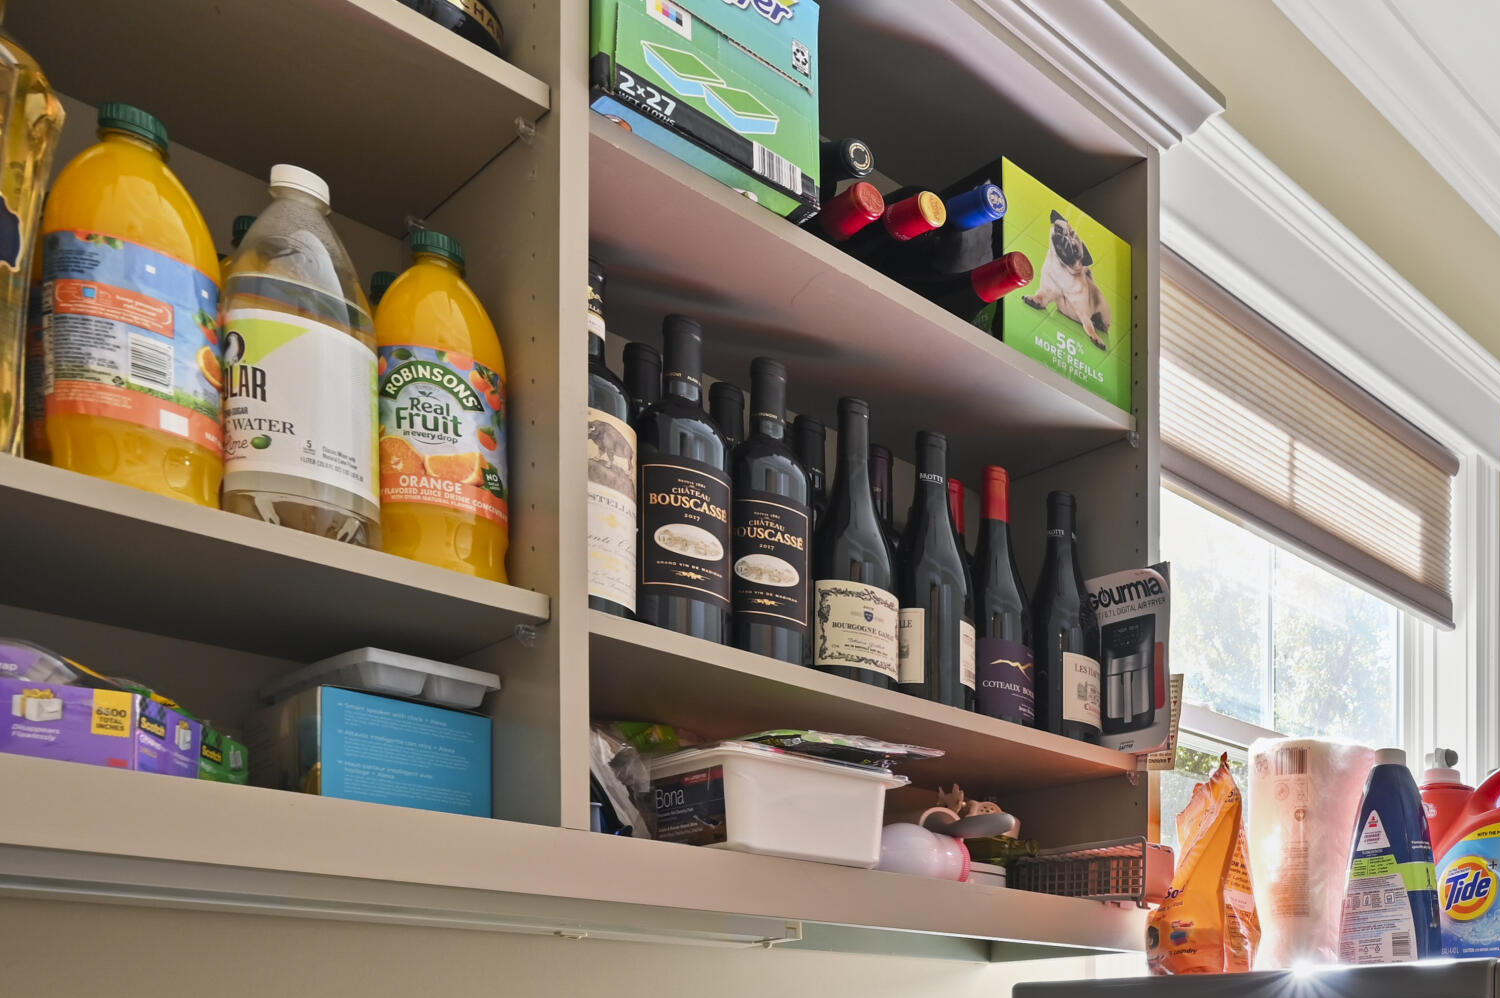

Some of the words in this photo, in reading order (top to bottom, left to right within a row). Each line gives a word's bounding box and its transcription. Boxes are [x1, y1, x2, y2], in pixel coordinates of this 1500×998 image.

[618, 91, 638, 108] WET
[641, 104, 676, 127] CLOTHS
[1052, 356, 1068, 371] PER
[1069, 366, 1088, 382] PACK
[1066, 354, 1104, 382] REFILLS
[385, 364, 478, 408] ROBINSONS
[410, 397, 450, 416] Real
[232, 418, 296, 436] WATER
[395, 406, 462, 438] Fruit
[403, 429, 410, 437] in
[411, 430, 438, 440] every
[438, 432, 458, 445] drop
[399, 475, 463, 495] ORANGE
[486, 473, 498, 482] NO
[420, 488, 442, 498] JUICE
[444, 492, 470, 504] DRINK
[672, 486, 711, 502] CHÂTEAU
[684, 513, 700, 522] 2017
[748, 518, 785, 532] CHÂTEAU
[760, 543, 775, 551] 2017
[1116, 605, 1136, 616] DIGITAL
[832, 622, 877, 635] BOURGOGNE
[982, 680, 1020, 692] COTEAUX
[96, 722, 124, 732] INCHES
[99, 716, 123, 725] TOTAL
[140, 716, 166, 736] Scotch
[202, 745, 223, 762] Scotch
[656, 788, 684, 809] Bona
[1445, 870, 1492, 912] Tide
